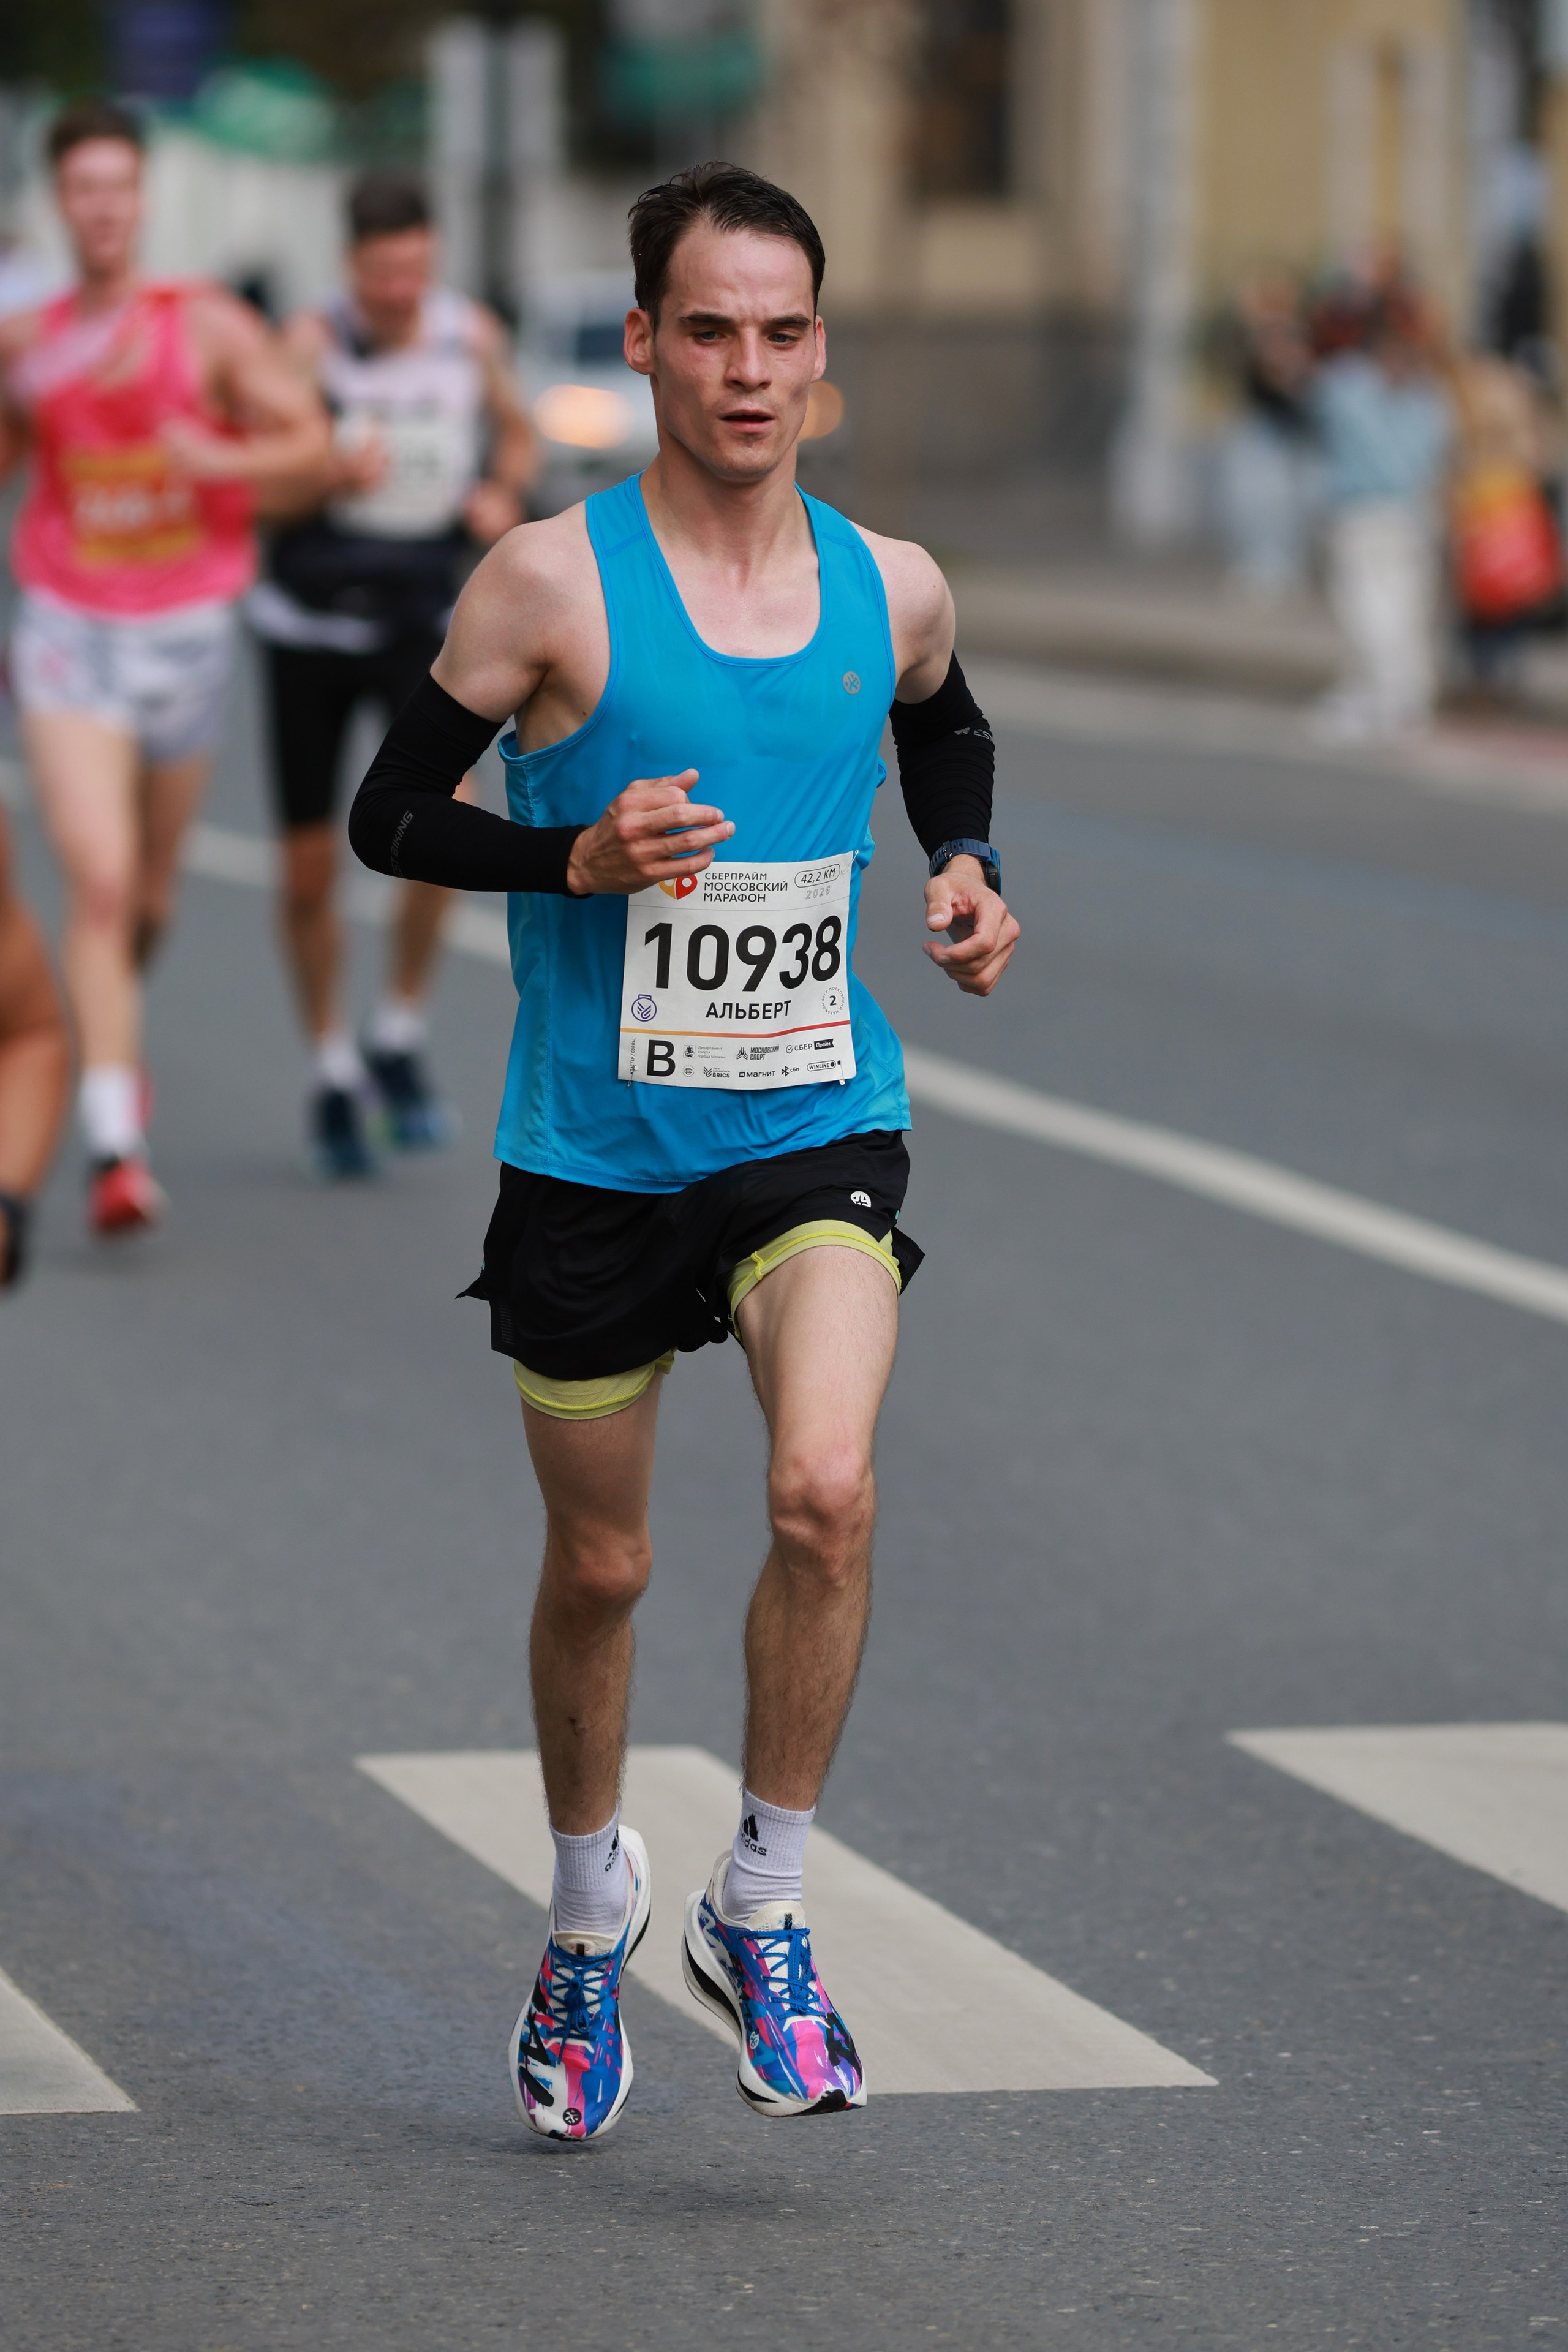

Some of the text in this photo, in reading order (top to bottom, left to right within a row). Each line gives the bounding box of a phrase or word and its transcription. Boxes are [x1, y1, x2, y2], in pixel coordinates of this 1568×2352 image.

[391, 810, 413, 858] BIKING
[801, 872, 821, 884] 42,2
[704, 881, 788, 891] МОСКОВСКИЙ
[704, 893, 766, 902] МАРАФОН
[805, 885, 831, 900] 2026
[644, 915, 842, 992] 10938
[829, 995, 837, 1006] 2
[705, 1000, 791, 1019] АЛЬБЕРТ
[750, 1044, 780, 1054] МОСКОВСКИЙ
